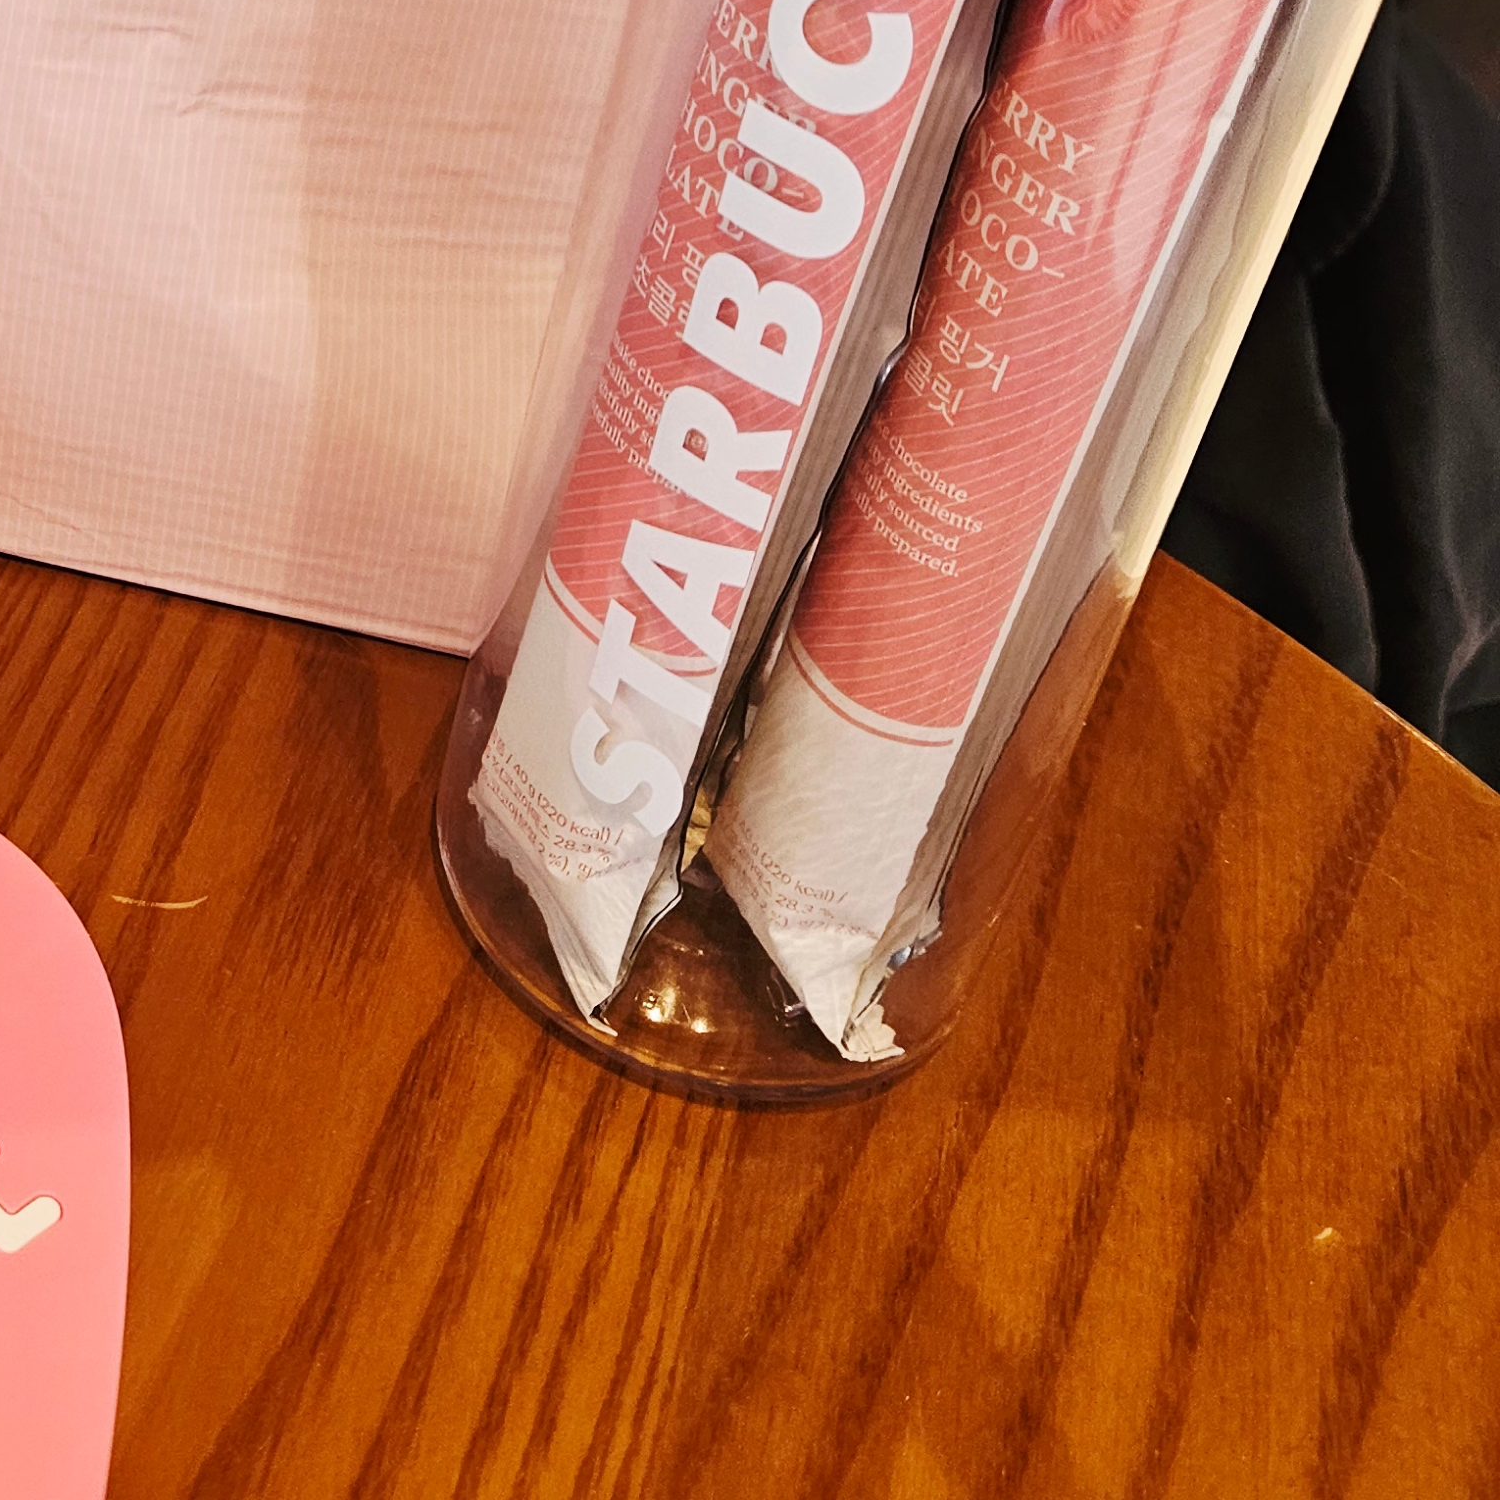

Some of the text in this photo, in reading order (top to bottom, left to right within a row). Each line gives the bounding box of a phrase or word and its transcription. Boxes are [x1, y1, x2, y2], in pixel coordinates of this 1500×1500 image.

[991, 81, 1095, 175] ERRY
[974, 126, 1080, 235] NGER
[961, 190, 1065, 278] OCO-
[938, 239, 1009, 318] ATE
[904, 350, 964, 426] 콜릿
[940, 315, 1010, 393] 핑거
[883, 458, 983, 533] ingredients
[889, 435, 968, 503] chocolate
[873, 515, 959, 577] prepared.
[888, 499, 960, 552] sourced
[537, 792, 568, 828] (220
[570, 821, 611, 845] kcal)
[553, 835, 592, 854] 28.3
[794, 879, 835, 902] kcal)
